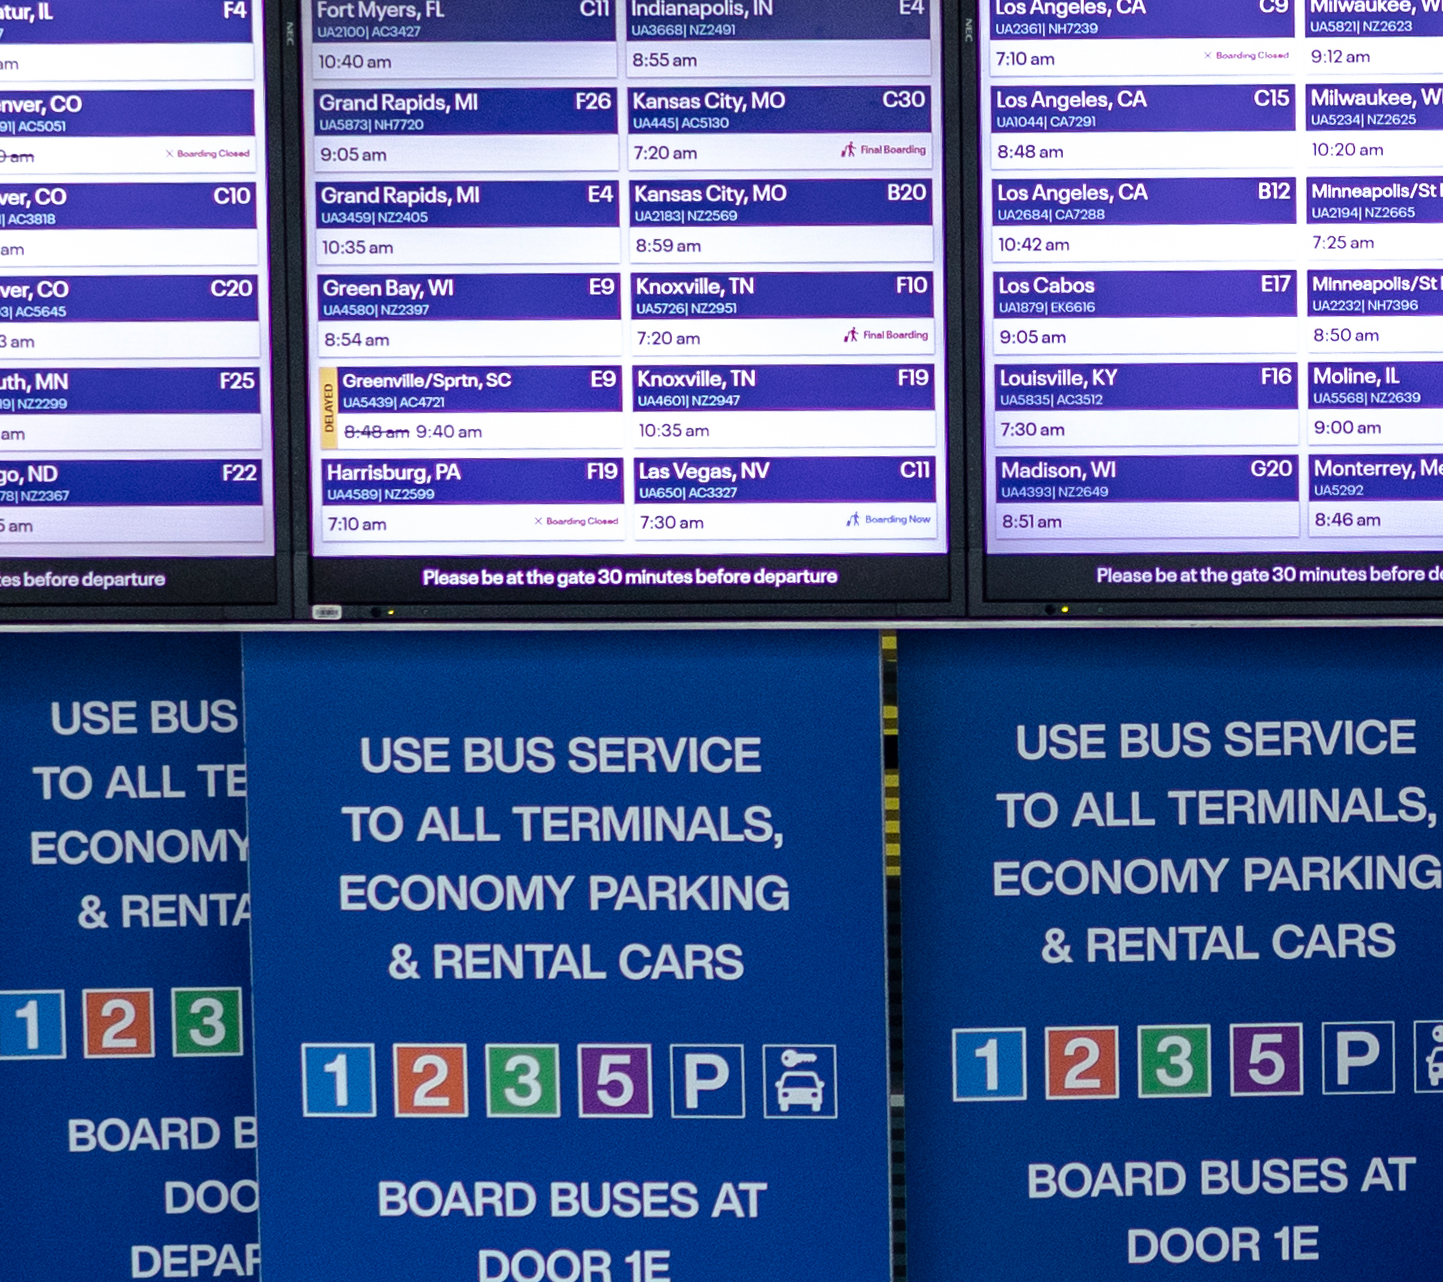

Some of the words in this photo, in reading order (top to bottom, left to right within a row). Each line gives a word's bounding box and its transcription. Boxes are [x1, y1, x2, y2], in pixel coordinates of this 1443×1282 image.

[965, 18, 973, 41] NEC
[320, 94, 377, 111] Grand
[382, 94, 450, 114] Rapids,
[456, 94, 477, 110] MI
[577, 92, 611, 109] F26
[860, 145, 883, 155] Final
[884, 145, 926, 157] Boarding
[324, 384, 334, 432] DELAYED
[1315, 460, 1415, 479] Monterrey,
[1315, 485, 1363, 496] UA5292
[1315, 512, 1352, 526] 8:46
[1357, 516, 1381, 526] am
[1018, 724, 1105, 760] USE
[1121, 722, 1211, 758] BUS
[1225, 720, 1416, 757] SERVICE
[996, 792, 1058, 828] TO
[1072, 791, 1155, 827] ALL
[1168, 787, 1436, 828] TERMINALS,
[994, 858, 1229, 896] ECONOMY
[1245, 854, 1441, 891] PARKING
[1042, 928, 1072, 963] &
[1088, 926, 1259, 962] RENTAL
[1273, 923, 1395, 959] CARS
[975, 1039, 998, 1090] 1
[1065, 1038, 1100, 1088] 2
[1157, 1036, 1192, 1086] 3
[1249, 1034, 1285, 1084] 5
[1337, 1031, 1380, 1085] P
[1029, 1162, 1185, 1198] BOARD
[1202, 1158, 1347, 1194] BUSES
[1361, 1157, 1416, 1191] AT
[1129, 1227, 1259, 1263] DOOR
[1274, 1226, 1319, 1260] 1E
